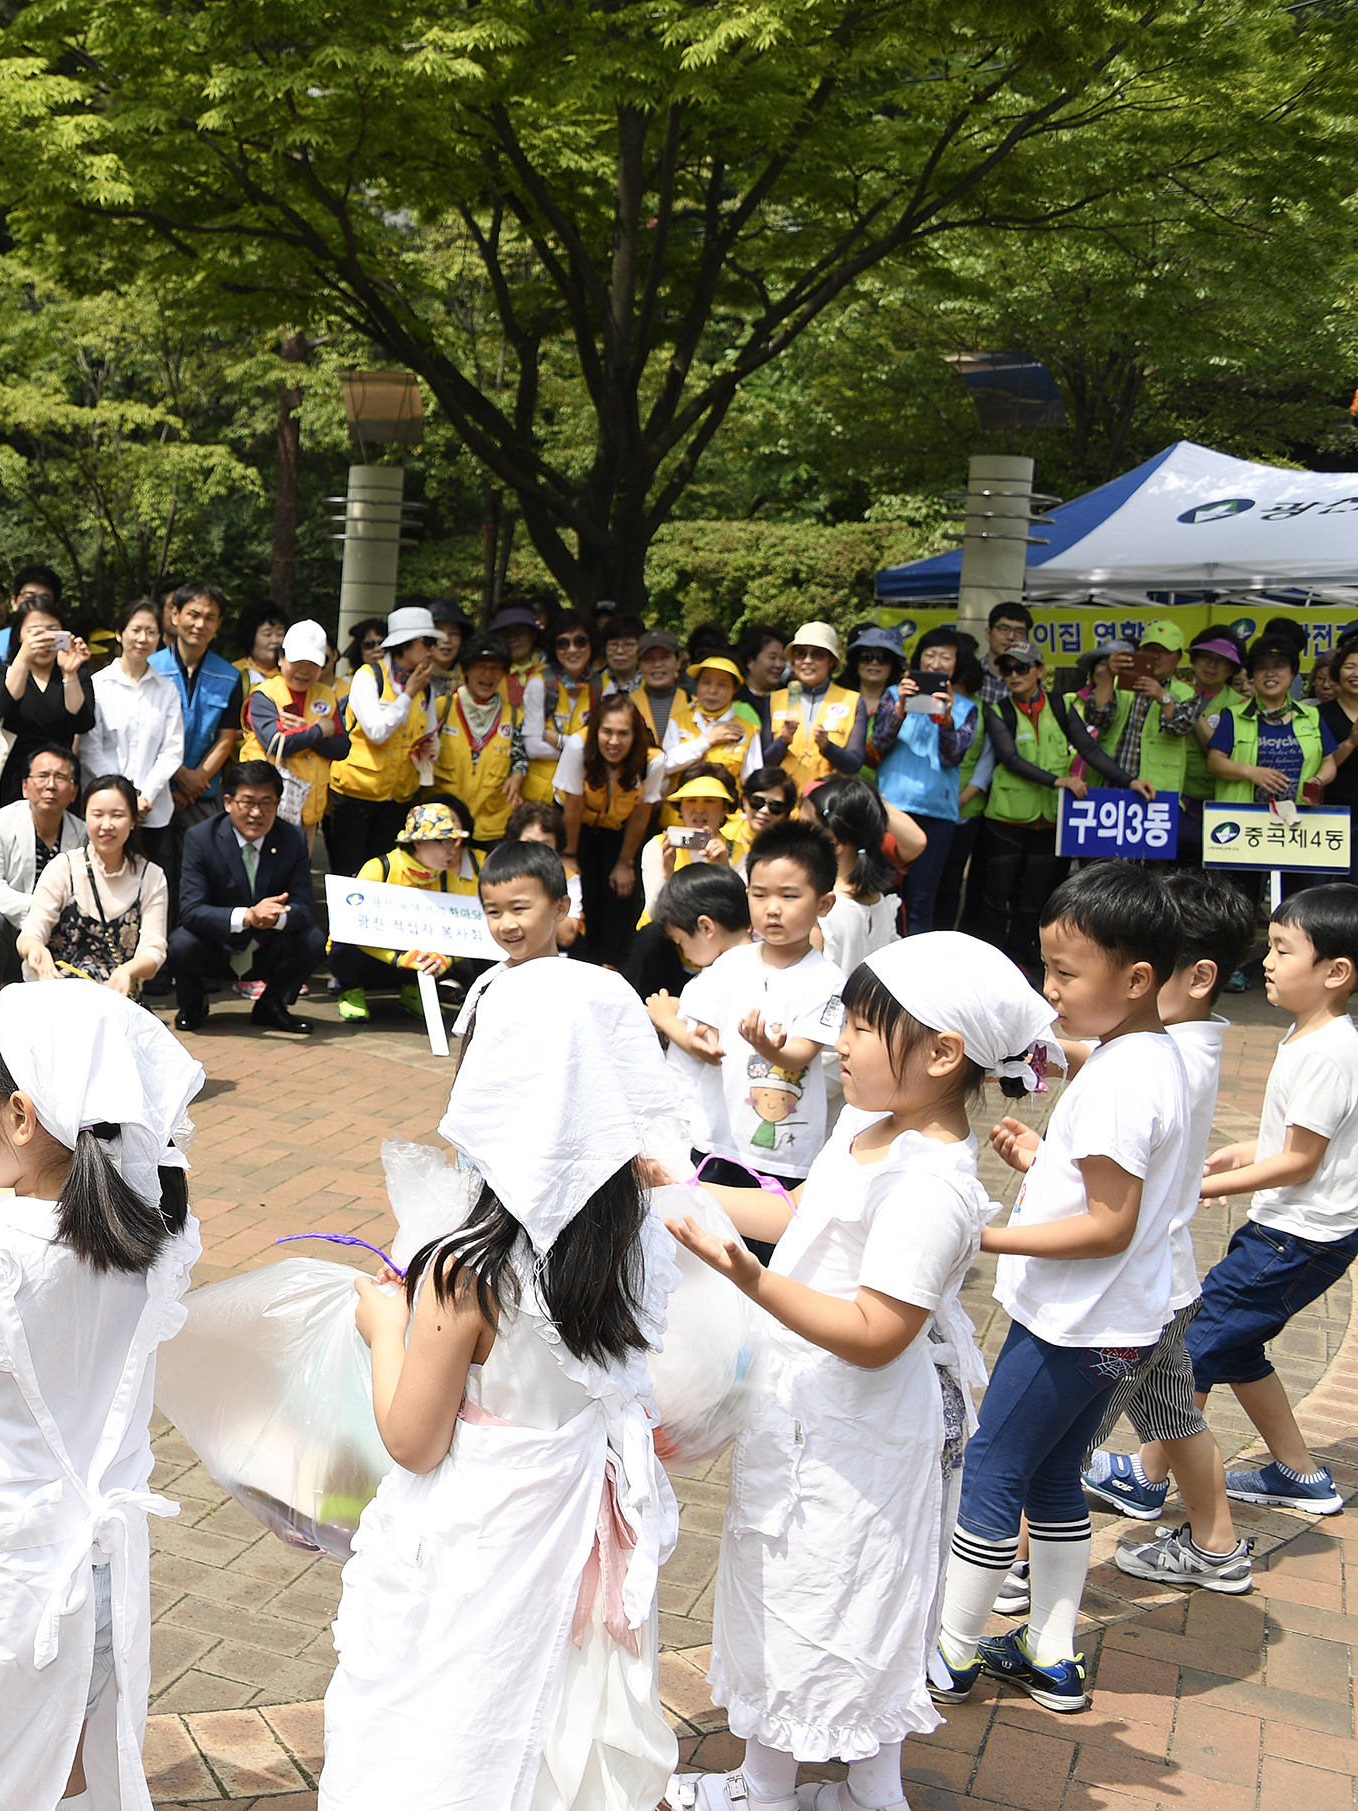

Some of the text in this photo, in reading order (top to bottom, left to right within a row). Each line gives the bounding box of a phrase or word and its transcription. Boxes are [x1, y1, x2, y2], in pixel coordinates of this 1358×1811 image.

[1032, 621, 1082, 654] 이집
[1068, 800, 1173, 848] 구의3동
[1244, 825, 1345, 852] 중곡제4동
[358, 914, 483, 943] 광진 적십자 봉사회
